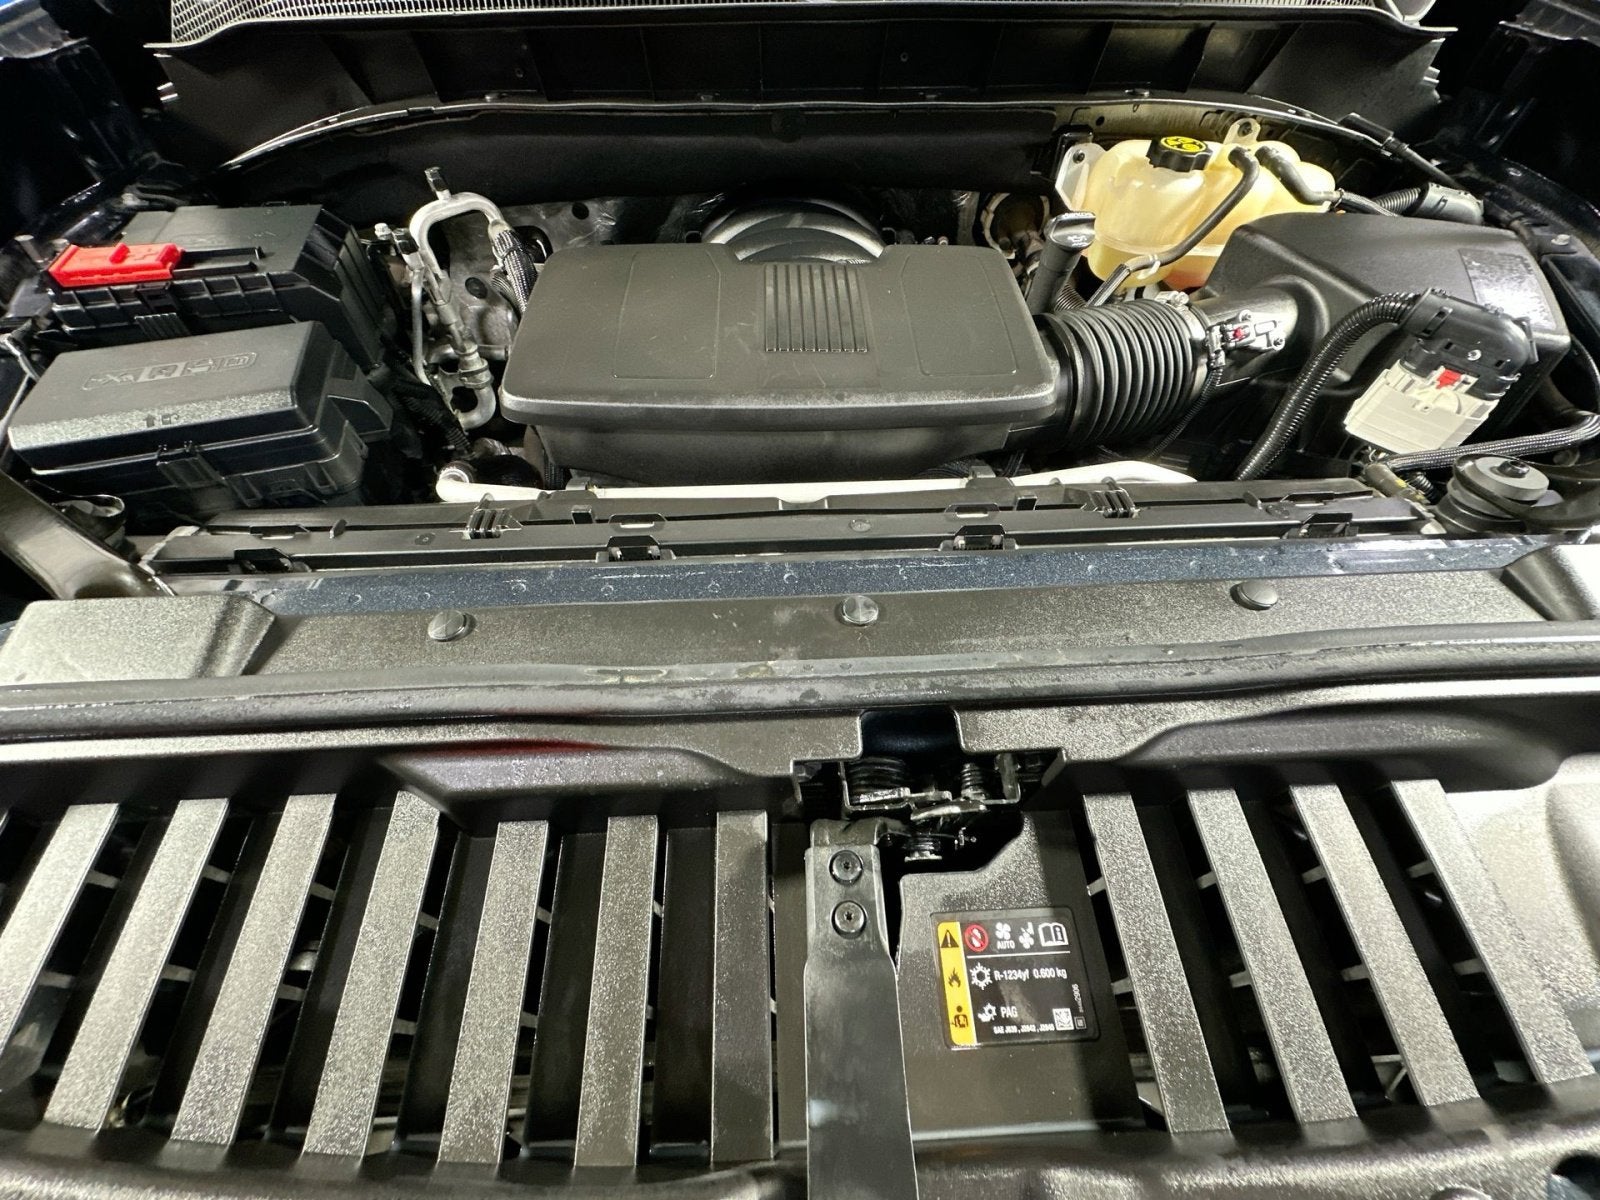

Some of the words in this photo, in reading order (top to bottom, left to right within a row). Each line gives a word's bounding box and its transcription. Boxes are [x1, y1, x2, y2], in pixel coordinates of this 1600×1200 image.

[997, 941, 1015, 949] AUTO
[994, 968, 1030, 983] R-1234yf
[1056, 967, 1067, 980] kg
[1000, 1006, 1018, 1018] PAG
